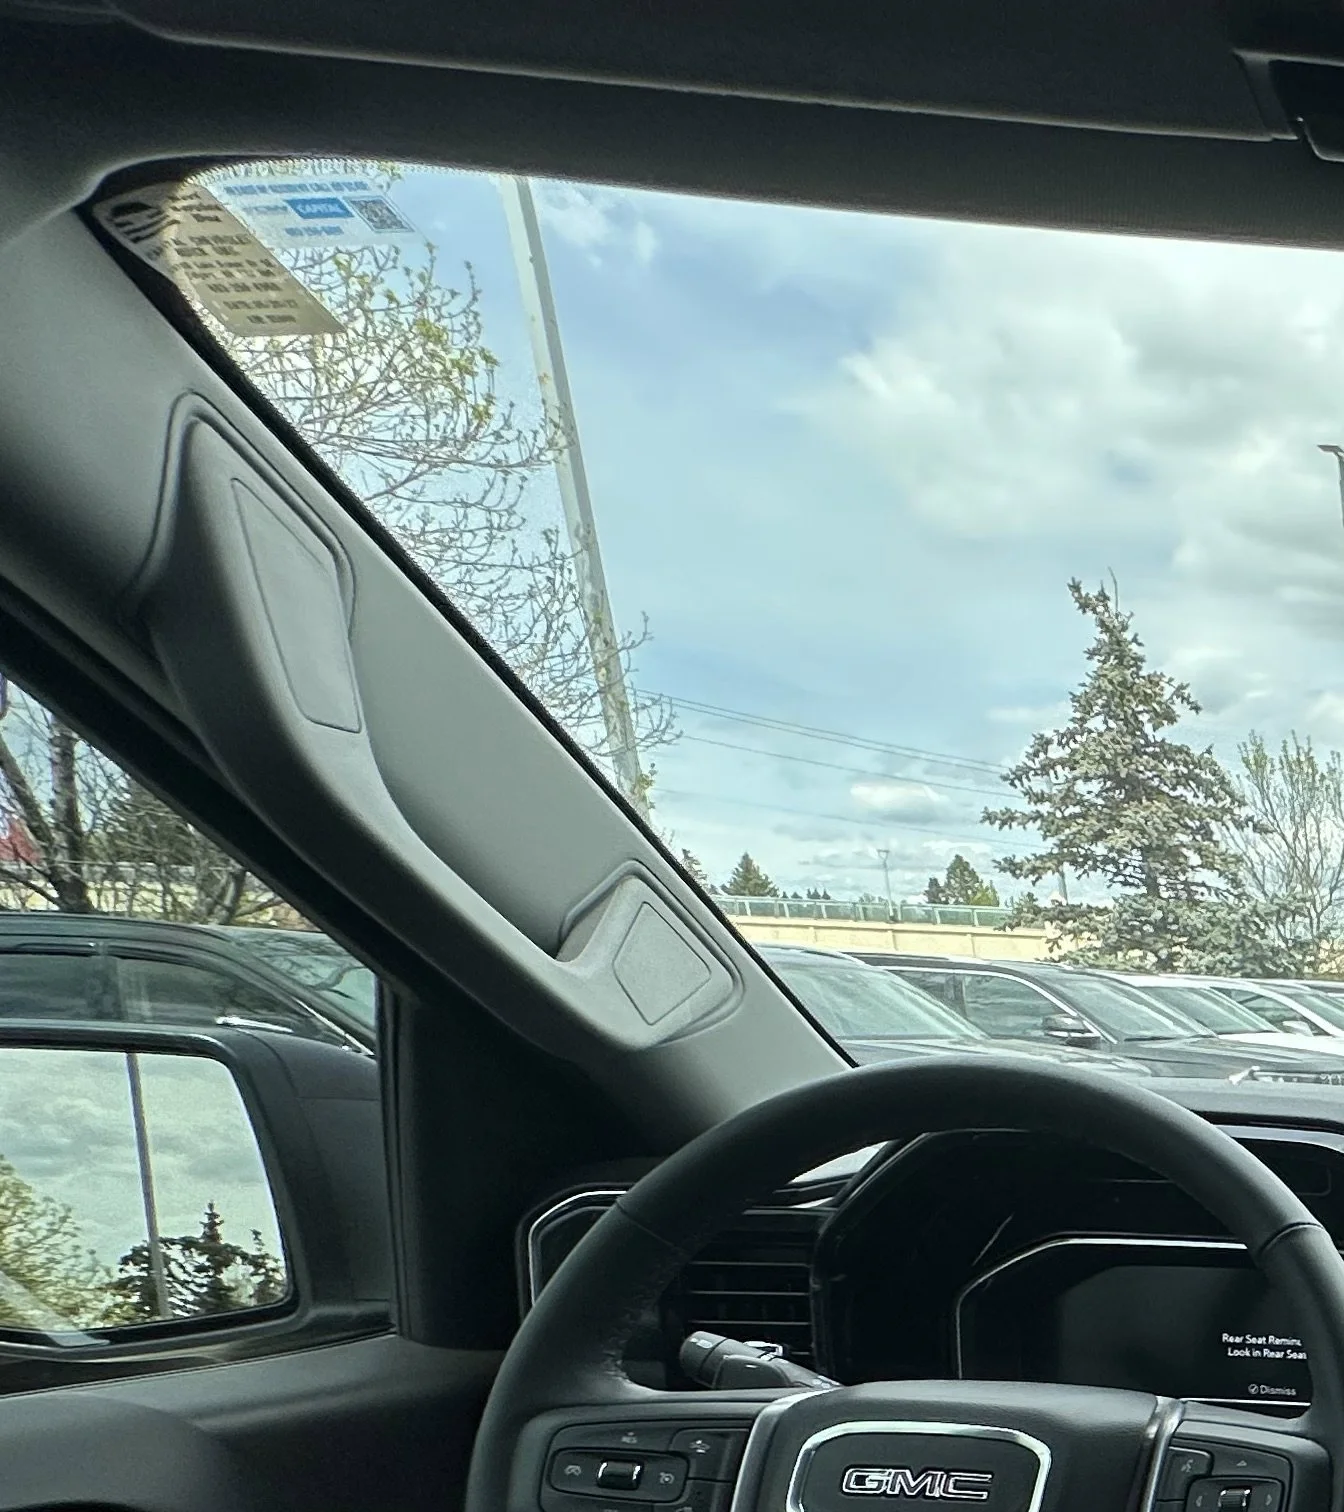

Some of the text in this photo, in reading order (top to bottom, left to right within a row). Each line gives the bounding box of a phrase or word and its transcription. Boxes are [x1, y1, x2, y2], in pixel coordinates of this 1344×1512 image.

[1222, 1333, 1243, 1344] Rear
[1245, 1334, 1267, 1344] Seat
[1227, 1347, 1251, 1357] Look
[1252, 1348, 1261, 1358] in
[1263, 1349, 1285, 1359] Rear
[1260, 1385, 1297, 1396] Dismiss
[841, 1467, 994, 1501] GMC
